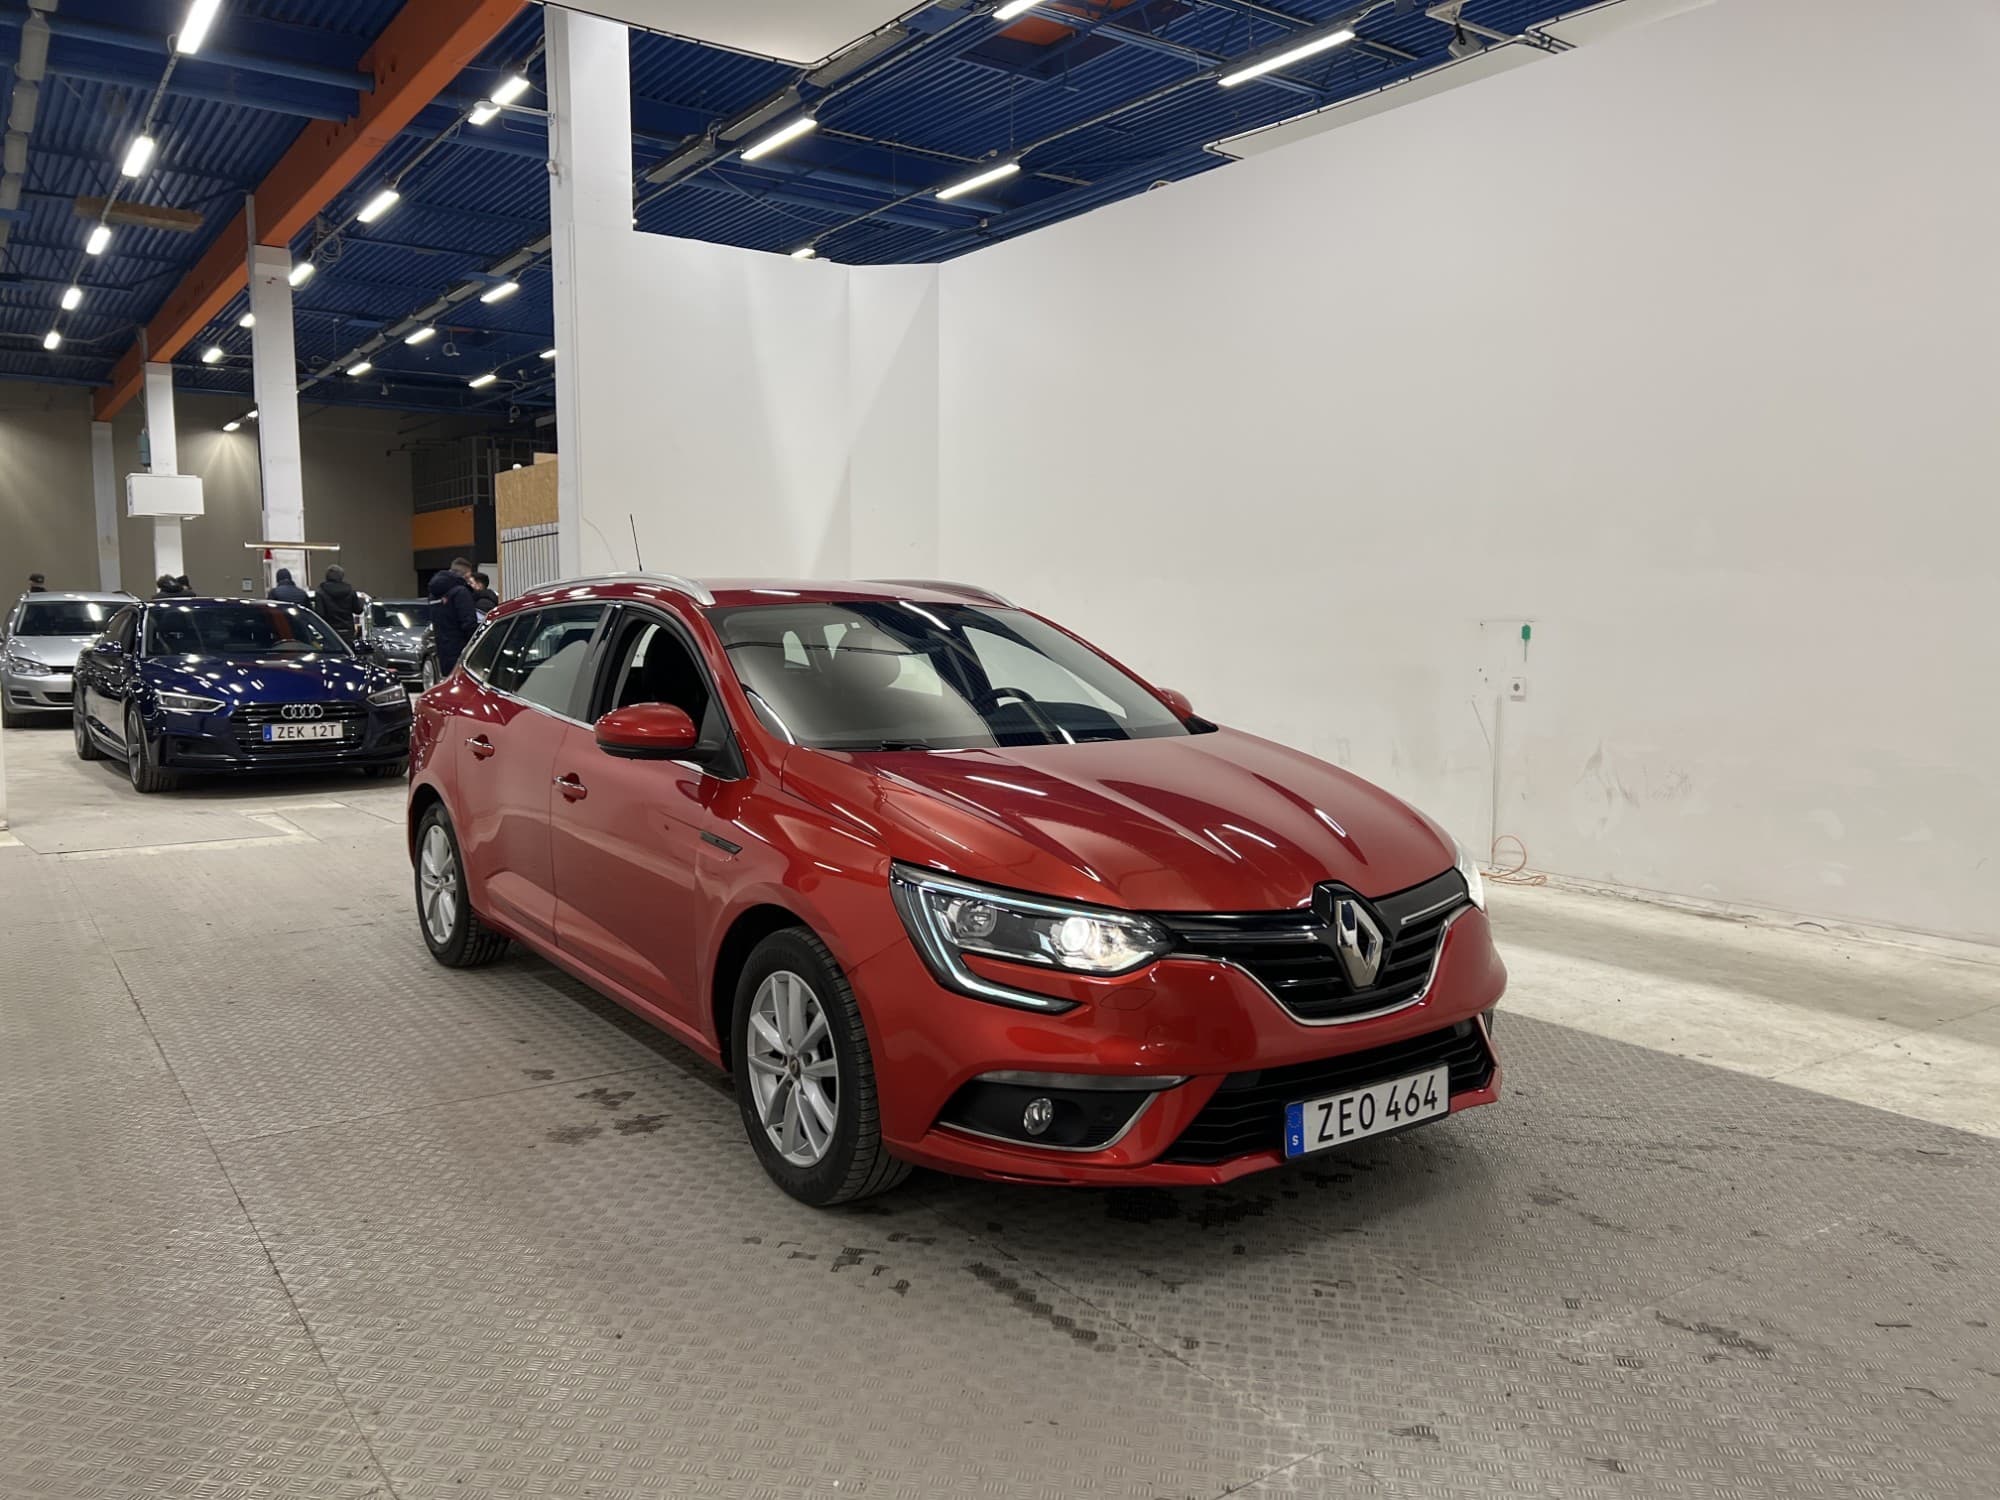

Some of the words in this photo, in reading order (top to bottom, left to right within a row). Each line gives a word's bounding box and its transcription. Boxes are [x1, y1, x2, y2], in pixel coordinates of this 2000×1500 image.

[277, 726, 304, 738] ZEK
[312, 725, 336, 737] 12T
[1317, 1093, 1375, 1143] ZEO
[1386, 1075, 1438, 1122] 464
[1292, 1135, 1299, 1146] S
